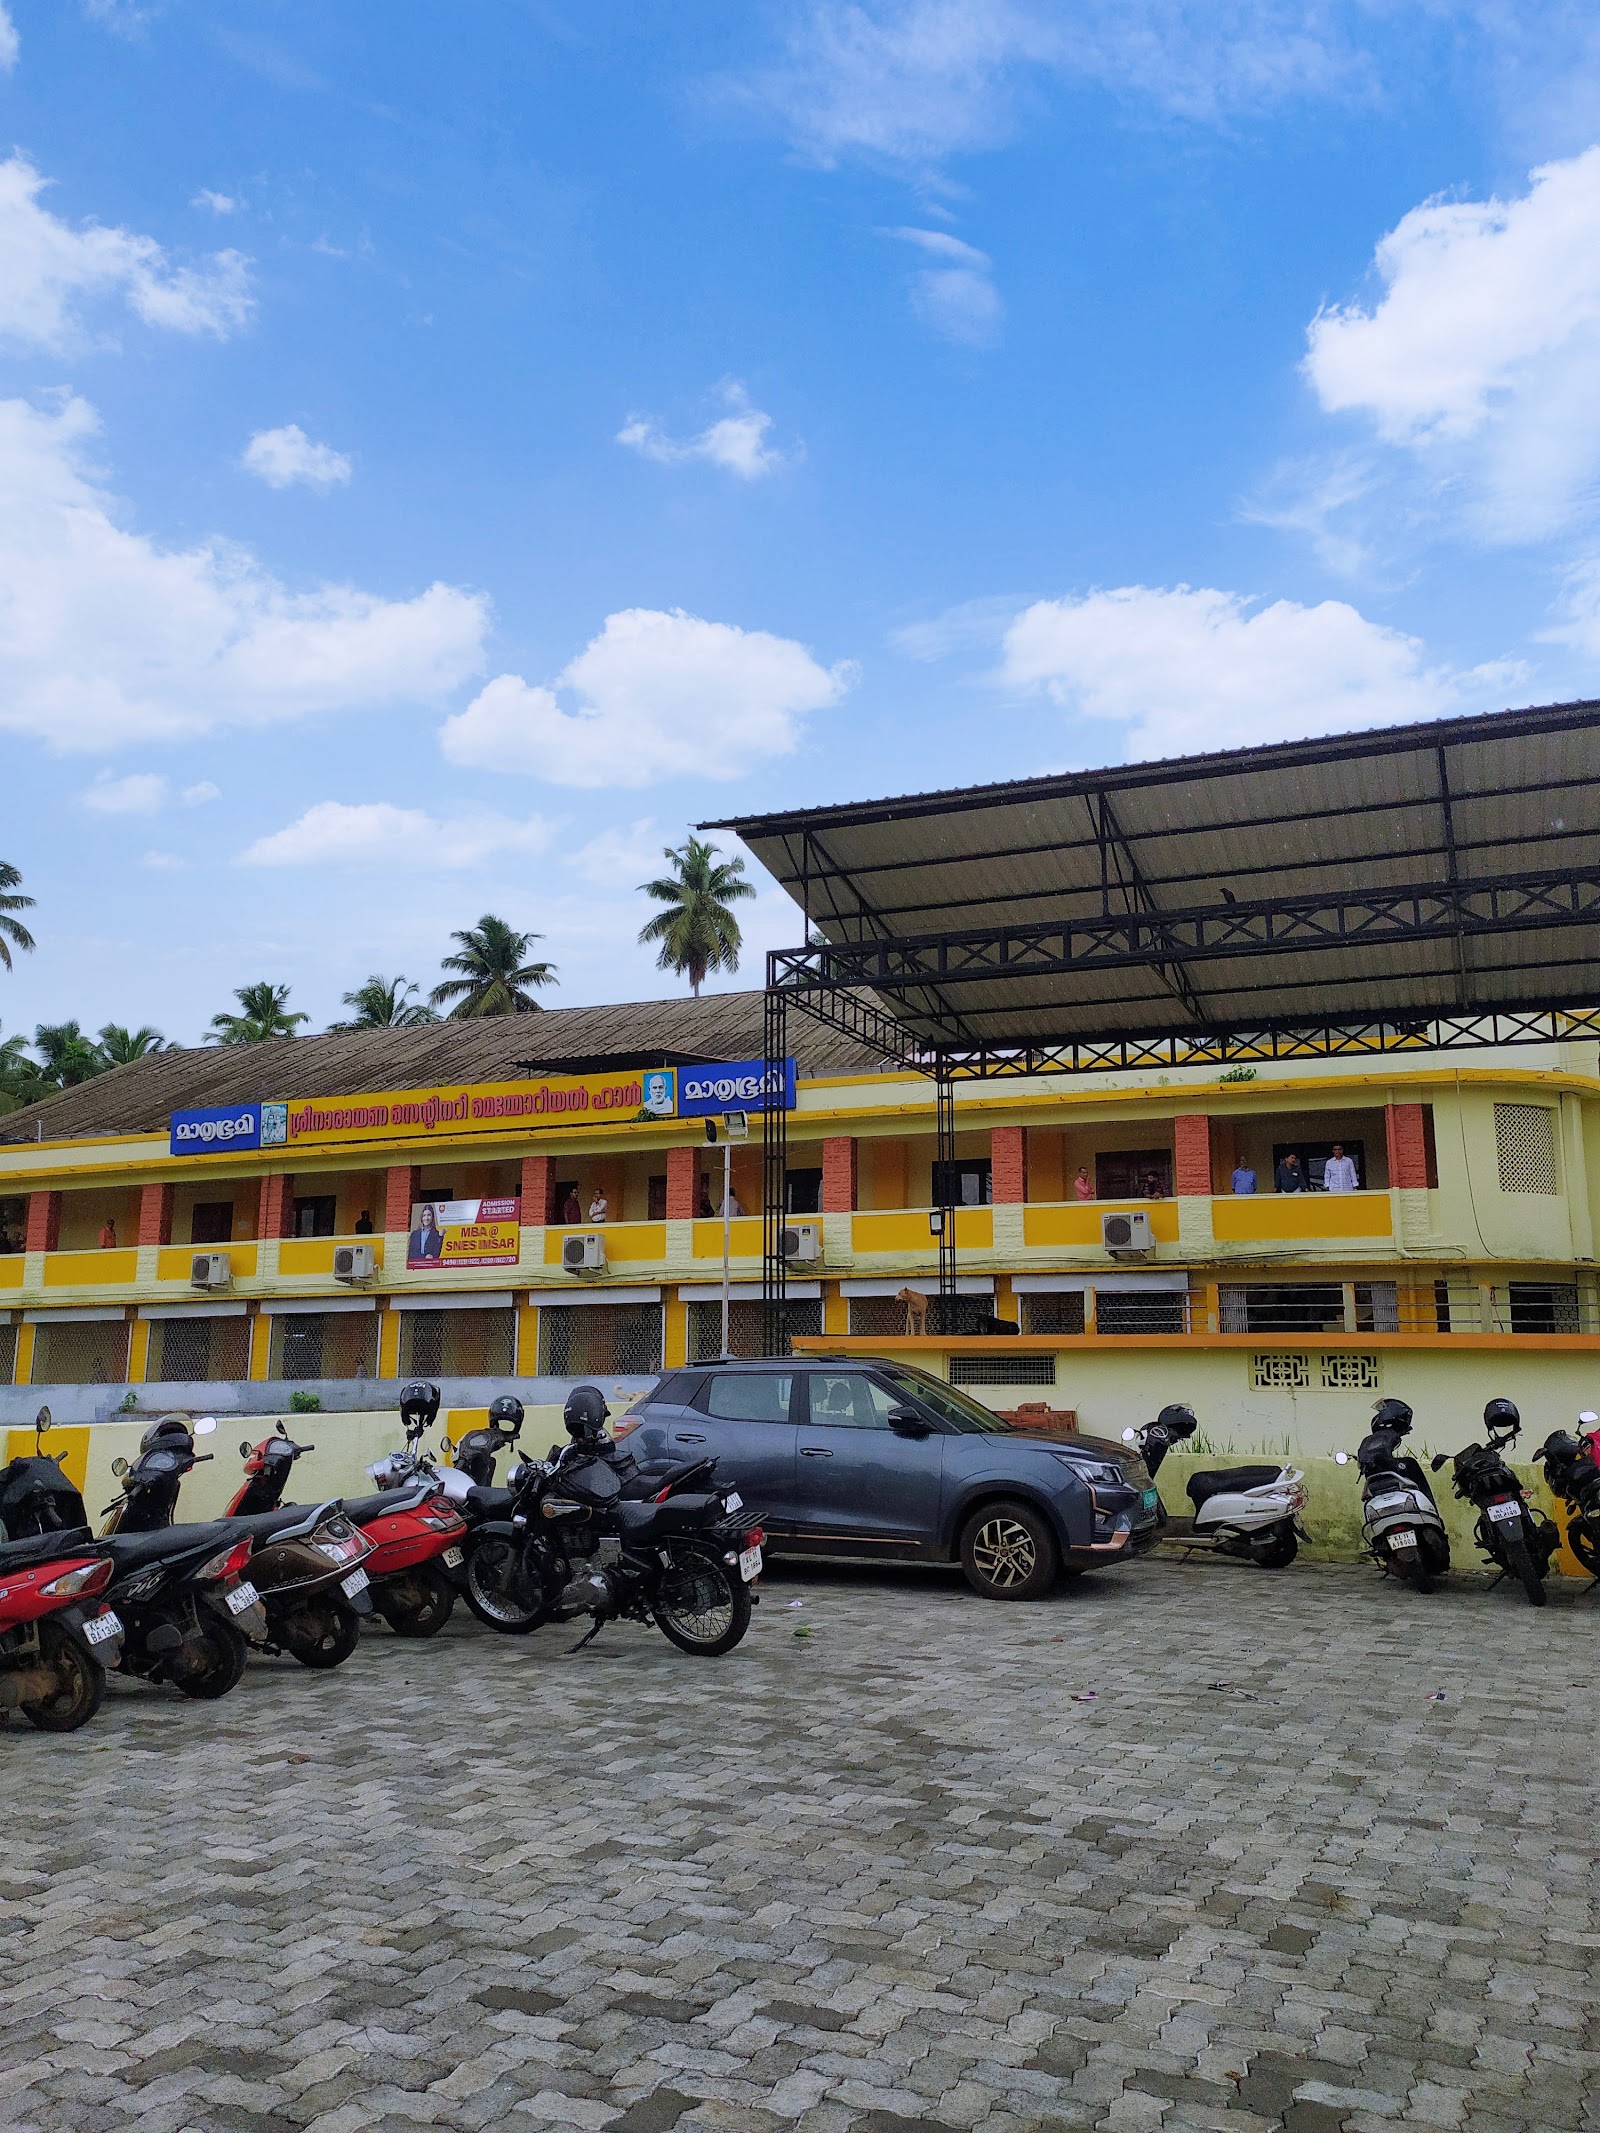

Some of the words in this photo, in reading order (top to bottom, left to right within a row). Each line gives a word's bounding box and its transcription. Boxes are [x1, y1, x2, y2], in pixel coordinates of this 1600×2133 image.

[290, 1105, 388, 1138] ശ്രീനാരായണ
[592, 1081, 642, 1109] ഹാൾ
[176, 1113, 255, 1142] മാതൃഭൂമി
[482, 1199, 515, 1207] ADMISSION
[482, 1206, 515, 1215] STARTED
[461, 1226, 488, 1238] MBA
[489, 1225, 499, 1239] @
[445, 1240, 477, 1252] SNES
